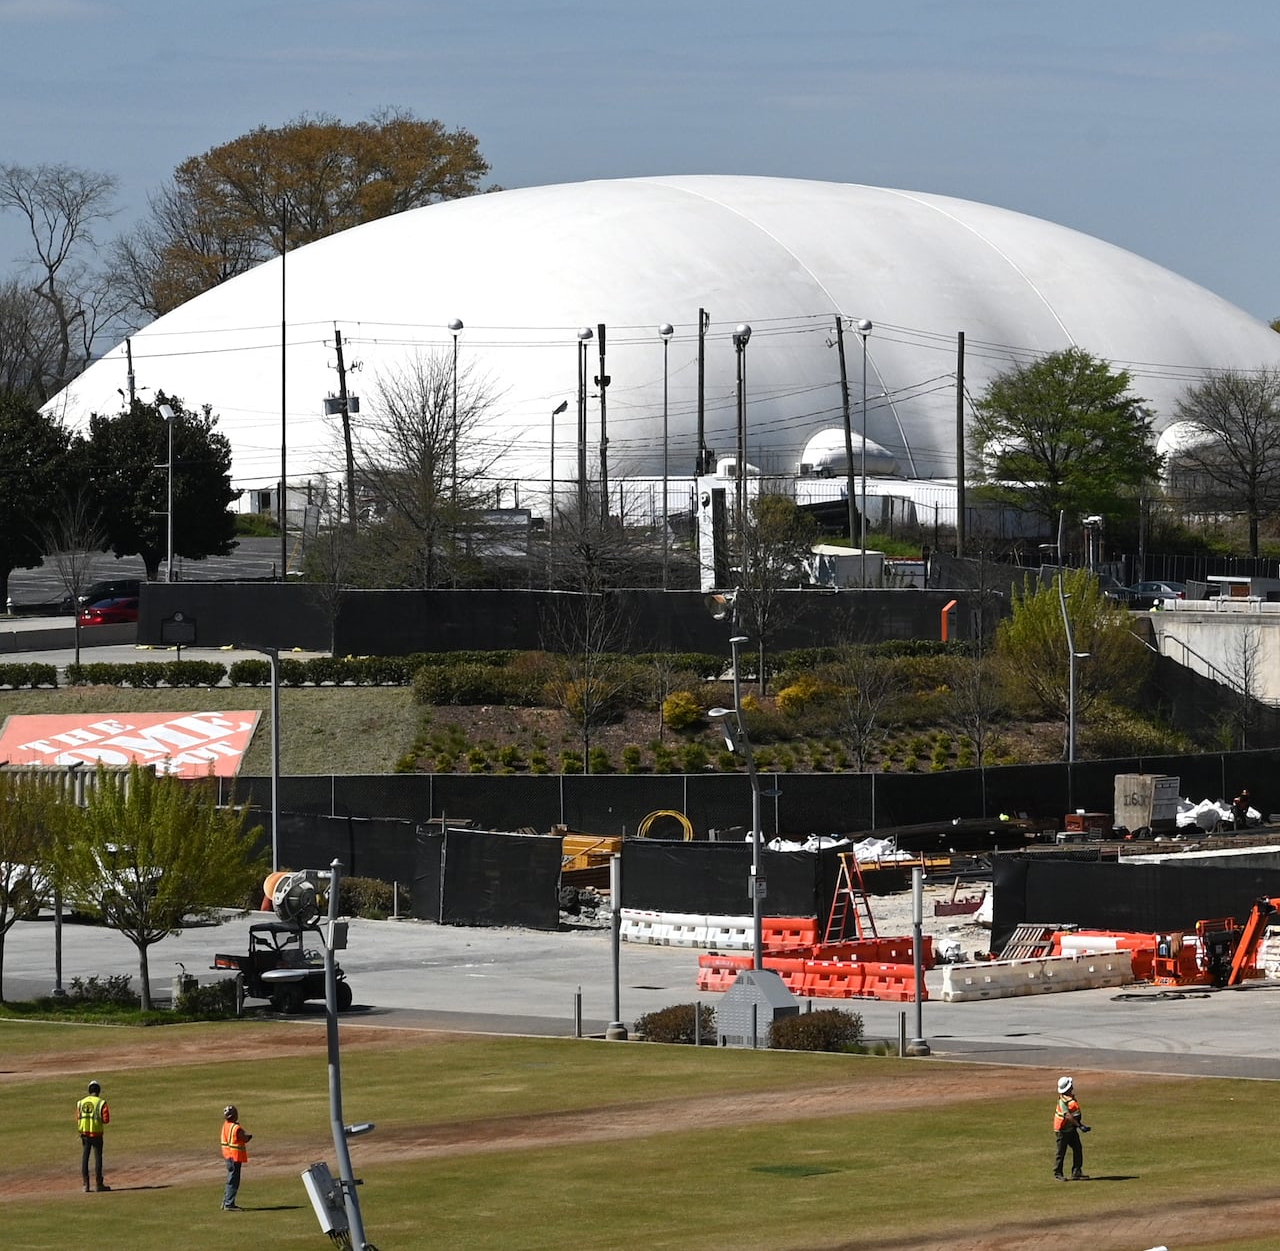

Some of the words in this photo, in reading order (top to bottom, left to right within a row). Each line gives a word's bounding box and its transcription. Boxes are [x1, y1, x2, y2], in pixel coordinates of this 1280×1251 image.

[17, 718, 136, 755] THE
[28, 712, 252, 765] OME
[143, 740, 243, 777] POT
